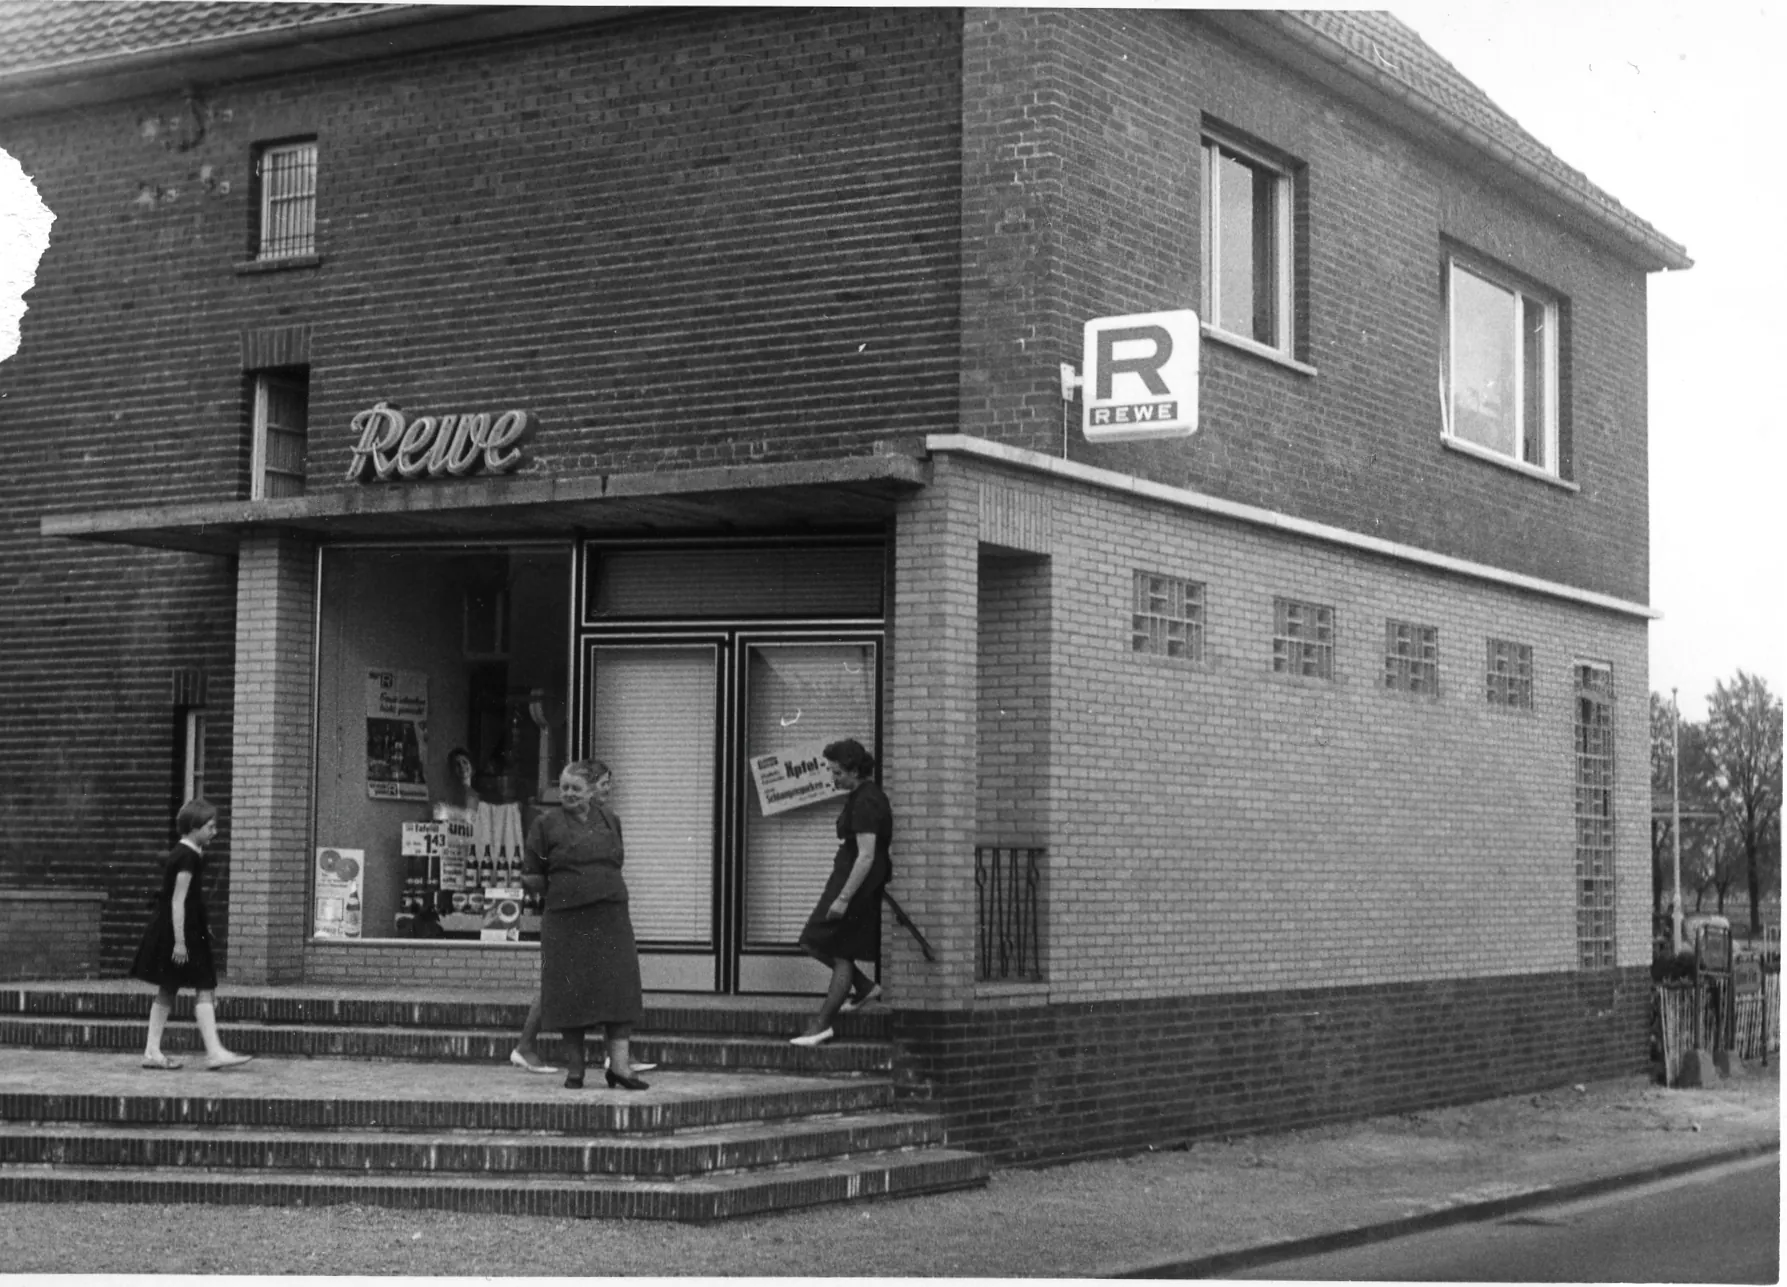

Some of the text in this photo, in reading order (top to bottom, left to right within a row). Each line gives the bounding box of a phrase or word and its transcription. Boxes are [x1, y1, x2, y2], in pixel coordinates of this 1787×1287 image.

[1096, 324, 1173, 400] R
[345, 401, 527, 480] Rewe
[1094, 403, 1173, 424] REWE
